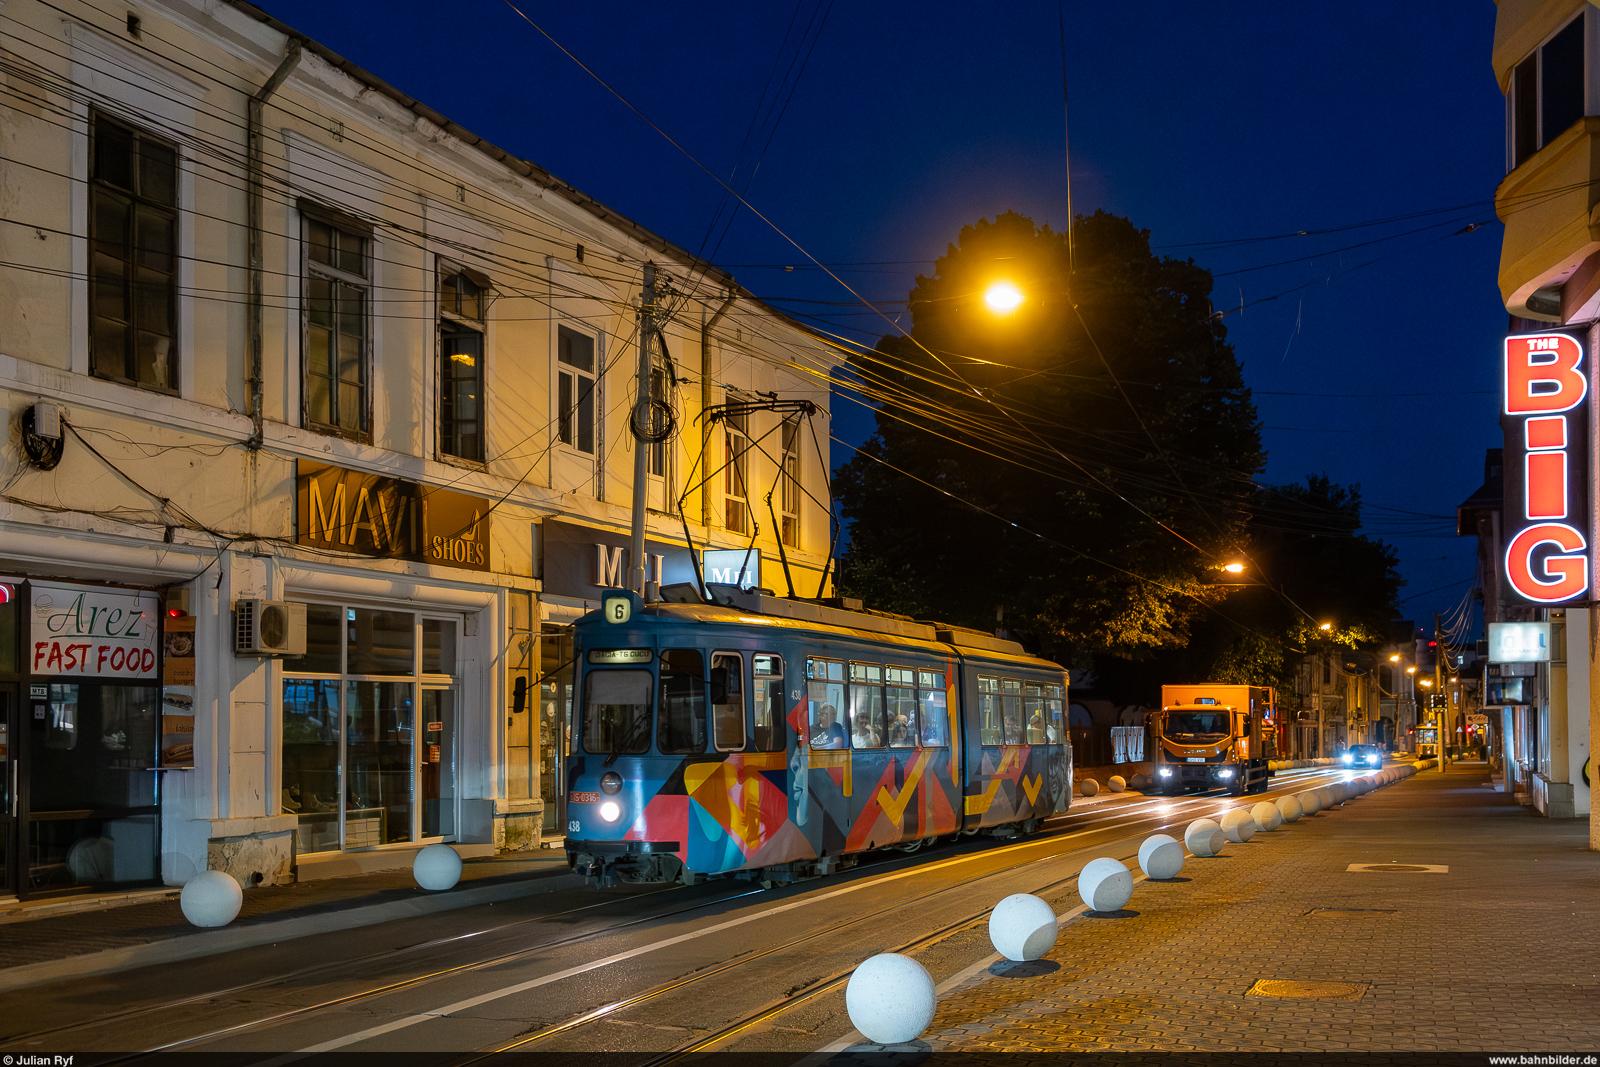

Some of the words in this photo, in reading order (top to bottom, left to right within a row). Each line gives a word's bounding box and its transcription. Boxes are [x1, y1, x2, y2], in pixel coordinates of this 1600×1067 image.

[1527, 338, 1559, 350] THE
[1504, 333, 1588, 603] BIG
[432, 535, 485, 566] SHOES
[595, 543, 665, 591] MI
[47, 592, 144, 637] Arez
[615, 604, 625, 620] 6
[34, 641, 92, 673] FAST
[97, 645, 156, 673] FOOD
[791, 689, 802, 701] 438
[568, 820, 581, 833] 438
